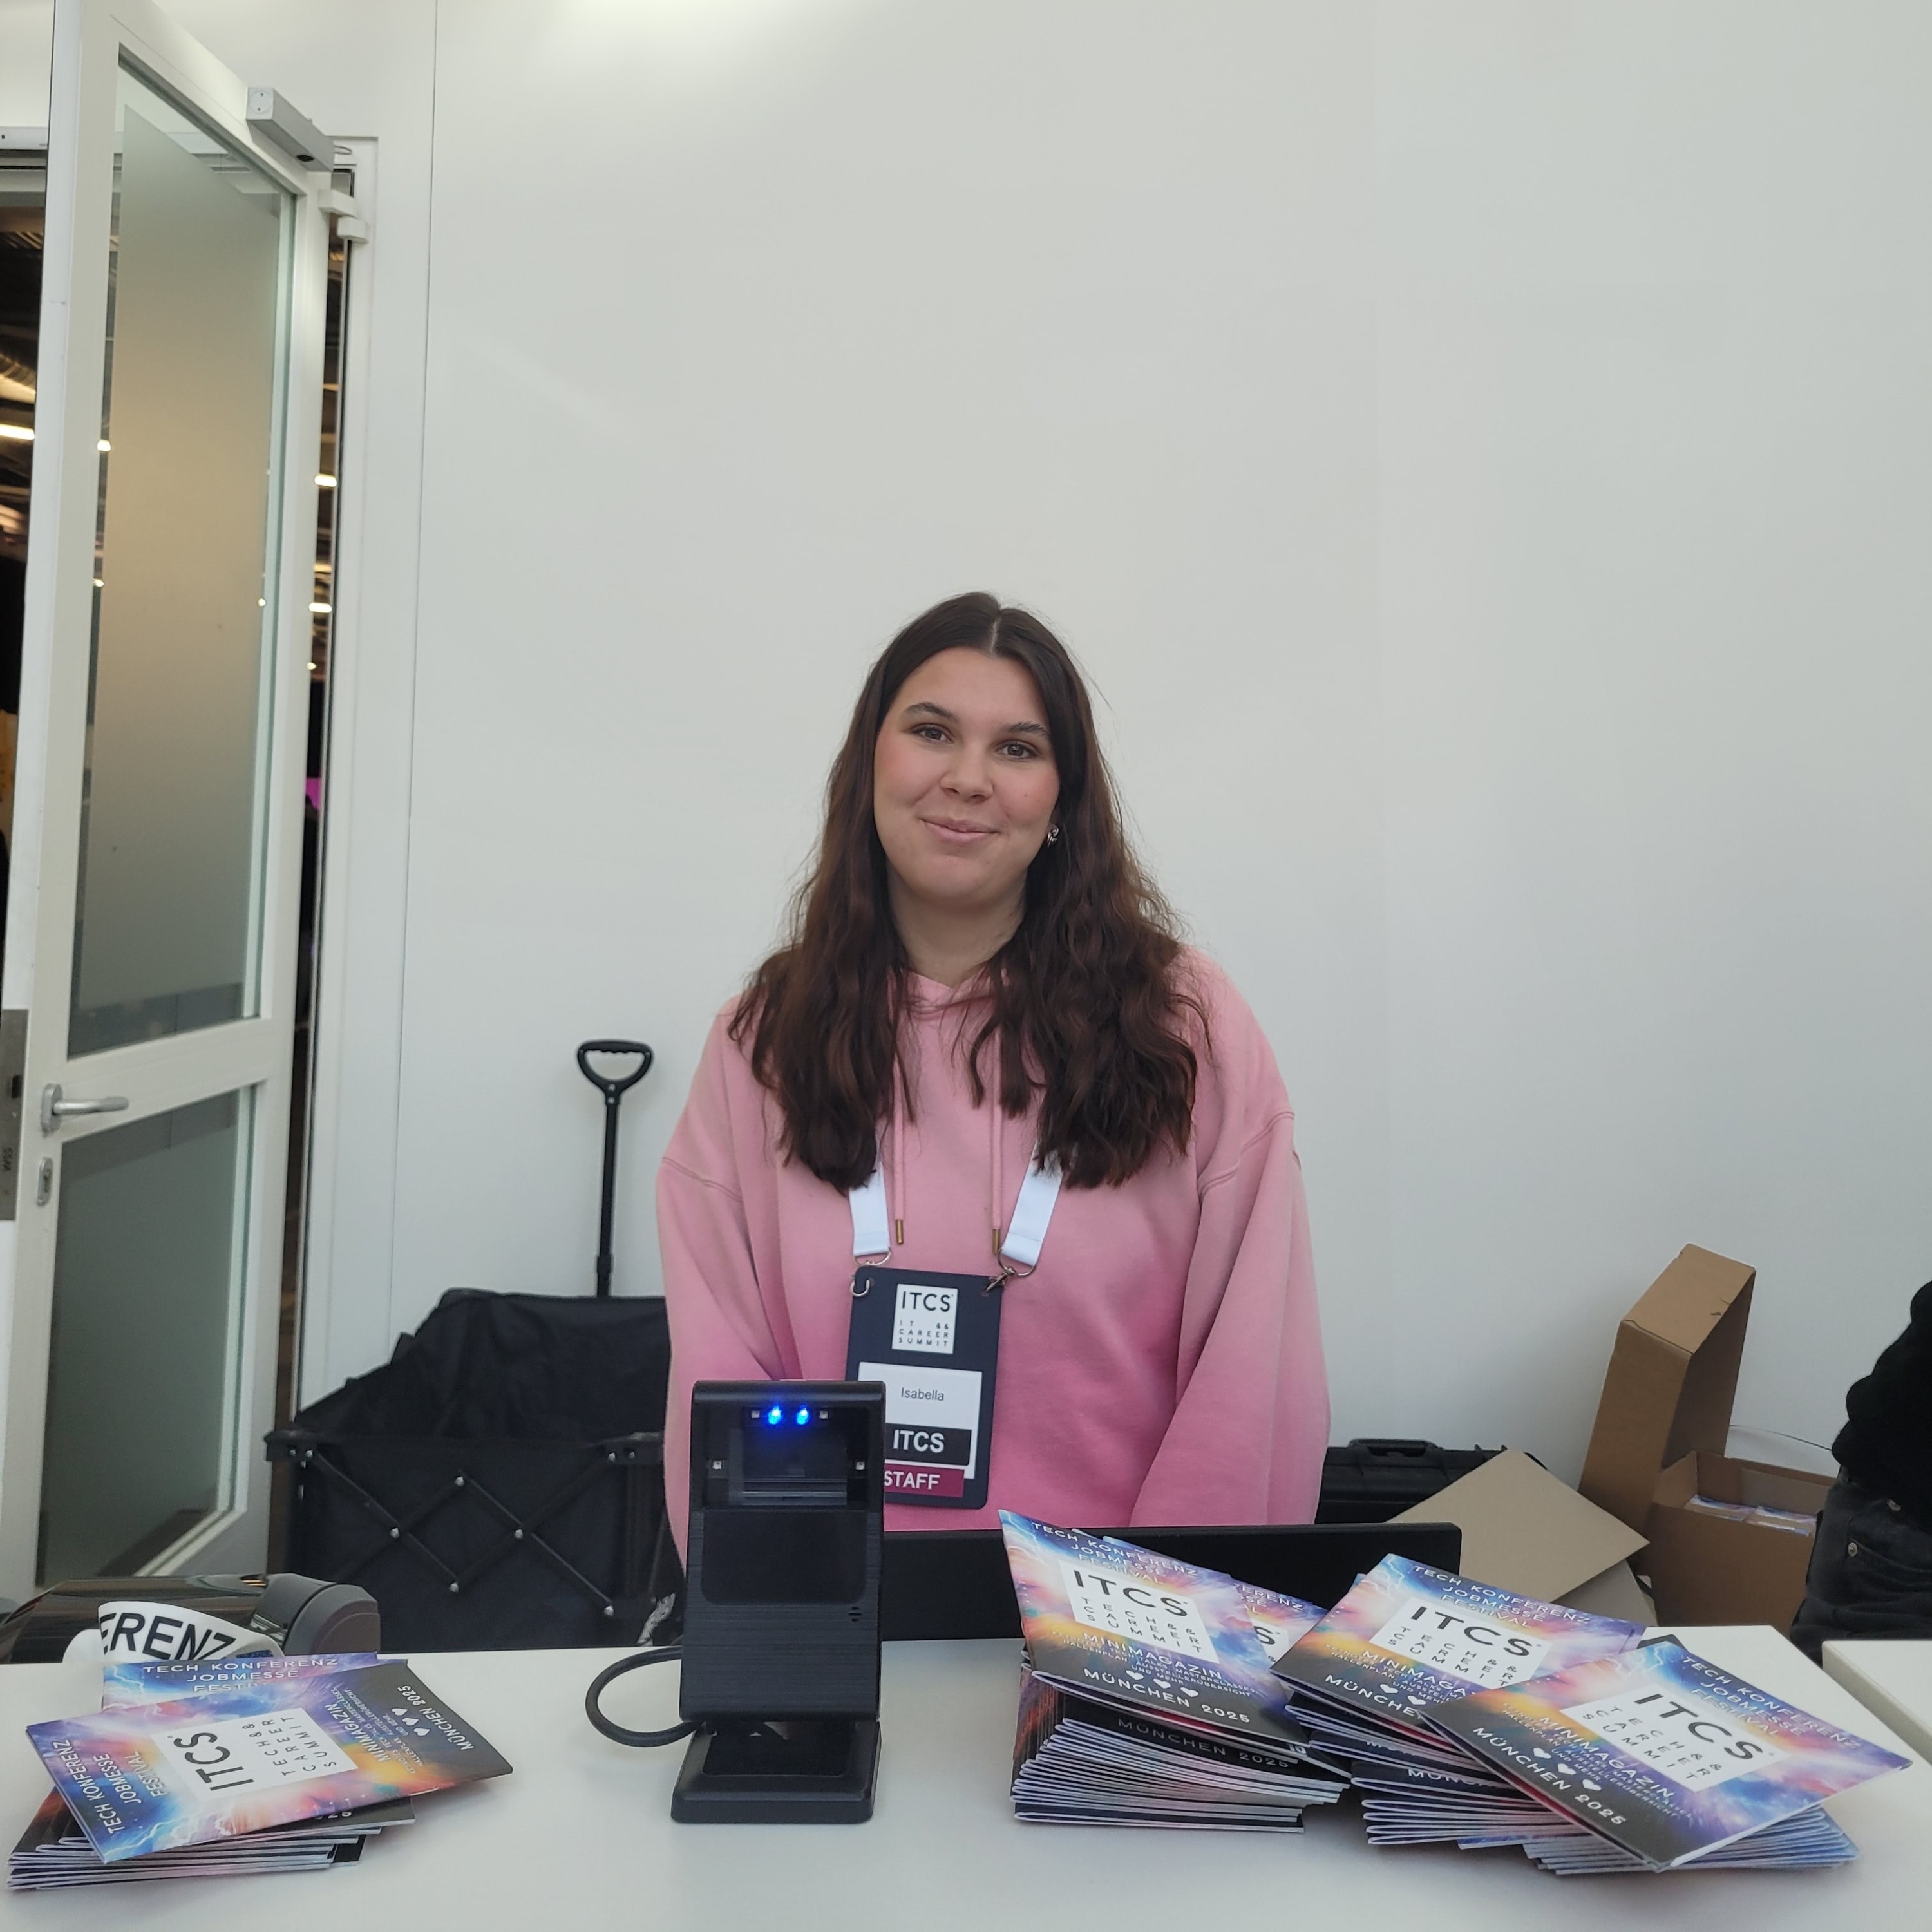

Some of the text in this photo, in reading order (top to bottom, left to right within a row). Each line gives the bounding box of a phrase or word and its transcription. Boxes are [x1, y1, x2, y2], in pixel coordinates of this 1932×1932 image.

[902, 1291, 951, 1312] ITCS
[898, 1337, 948, 1347] SUMMIT
[899, 1329, 949, 1338] CAREER
[901, 1387, 944, 1401] Isabella
[893, 1429, 945, 1453] ITCS
[884, 1470, 940, 1490] STAFF
[1031, 1522, 1198, 1577] TECH KONFERENZ
[1072, 1544, 1167, 1577] JOBMESSE
[1079, 1554, 1165, 1585] FESTIVAL
[1074, 1570, 1188, 1616] ITCS
[1414, 1565, 1591, 1625] TECH KONFERENZ
[1441, 1595, 1533, 1629] FESTIVAL
[1443, 1586, 1546, 1622] JOBMESSE
[1084, 1606, 1199, 1644] CAREER
[1087, 1615, 1202, 1653] SUMMIT
[1411, 1606, 1533, 1657] ITCS
[143, 1658, 339, 1673] TECH KONFERENZ
[186, 1671, 299, 1682] JOBMESSE
[1084, 1632, 1222, 1680] MINIMAGAZIN
[1362, 1650, 1475, 1697] MINIMAGA
[1388, 1639, 1509, 1687] SUMMIT
[1394, 1633, 1513, 1680] CAREER
[397, 1685, 475, 1750] MÜNCHEN 2025
[1084, 1668, 1250, 1724] MÜNCHEN 2025
[1324, 1674, 1419, 1718] MÜNCHE
[1683, 1656, 1862, 1749] TECH KONFERENZ
[1690, 1689, 1781, 1738] FESTIVAL
[1700, 1682, 1806, 1736] JOBMESSE
[261, 1719, 316, 1772] CAREER
[281, 1717, 337, 1767] SUMMIT
[324, 1703, 392, 1762] MINIMAGAZIN
[1582, 1713, 1698, 1779] SUMMIT
[1596, 1710, 1710, 1777] CAREER
[1634, 1694, 1763, 1759] ITCS
[93, 1753, 142, 1804] JOBMESSE
[126, 1750, 169, 1797] FESTIVAL
[173, 1732, 254, 1791] ITCS
[1473, 1727, 1571, 1791] MÜNCHEN
[1575, 1794, 1627, 1825] 2025
[1540, 1716, 1675, 1799] MINIMAGAZIN
[52, 1739, 125, 1835] TECH KONFERENZ
